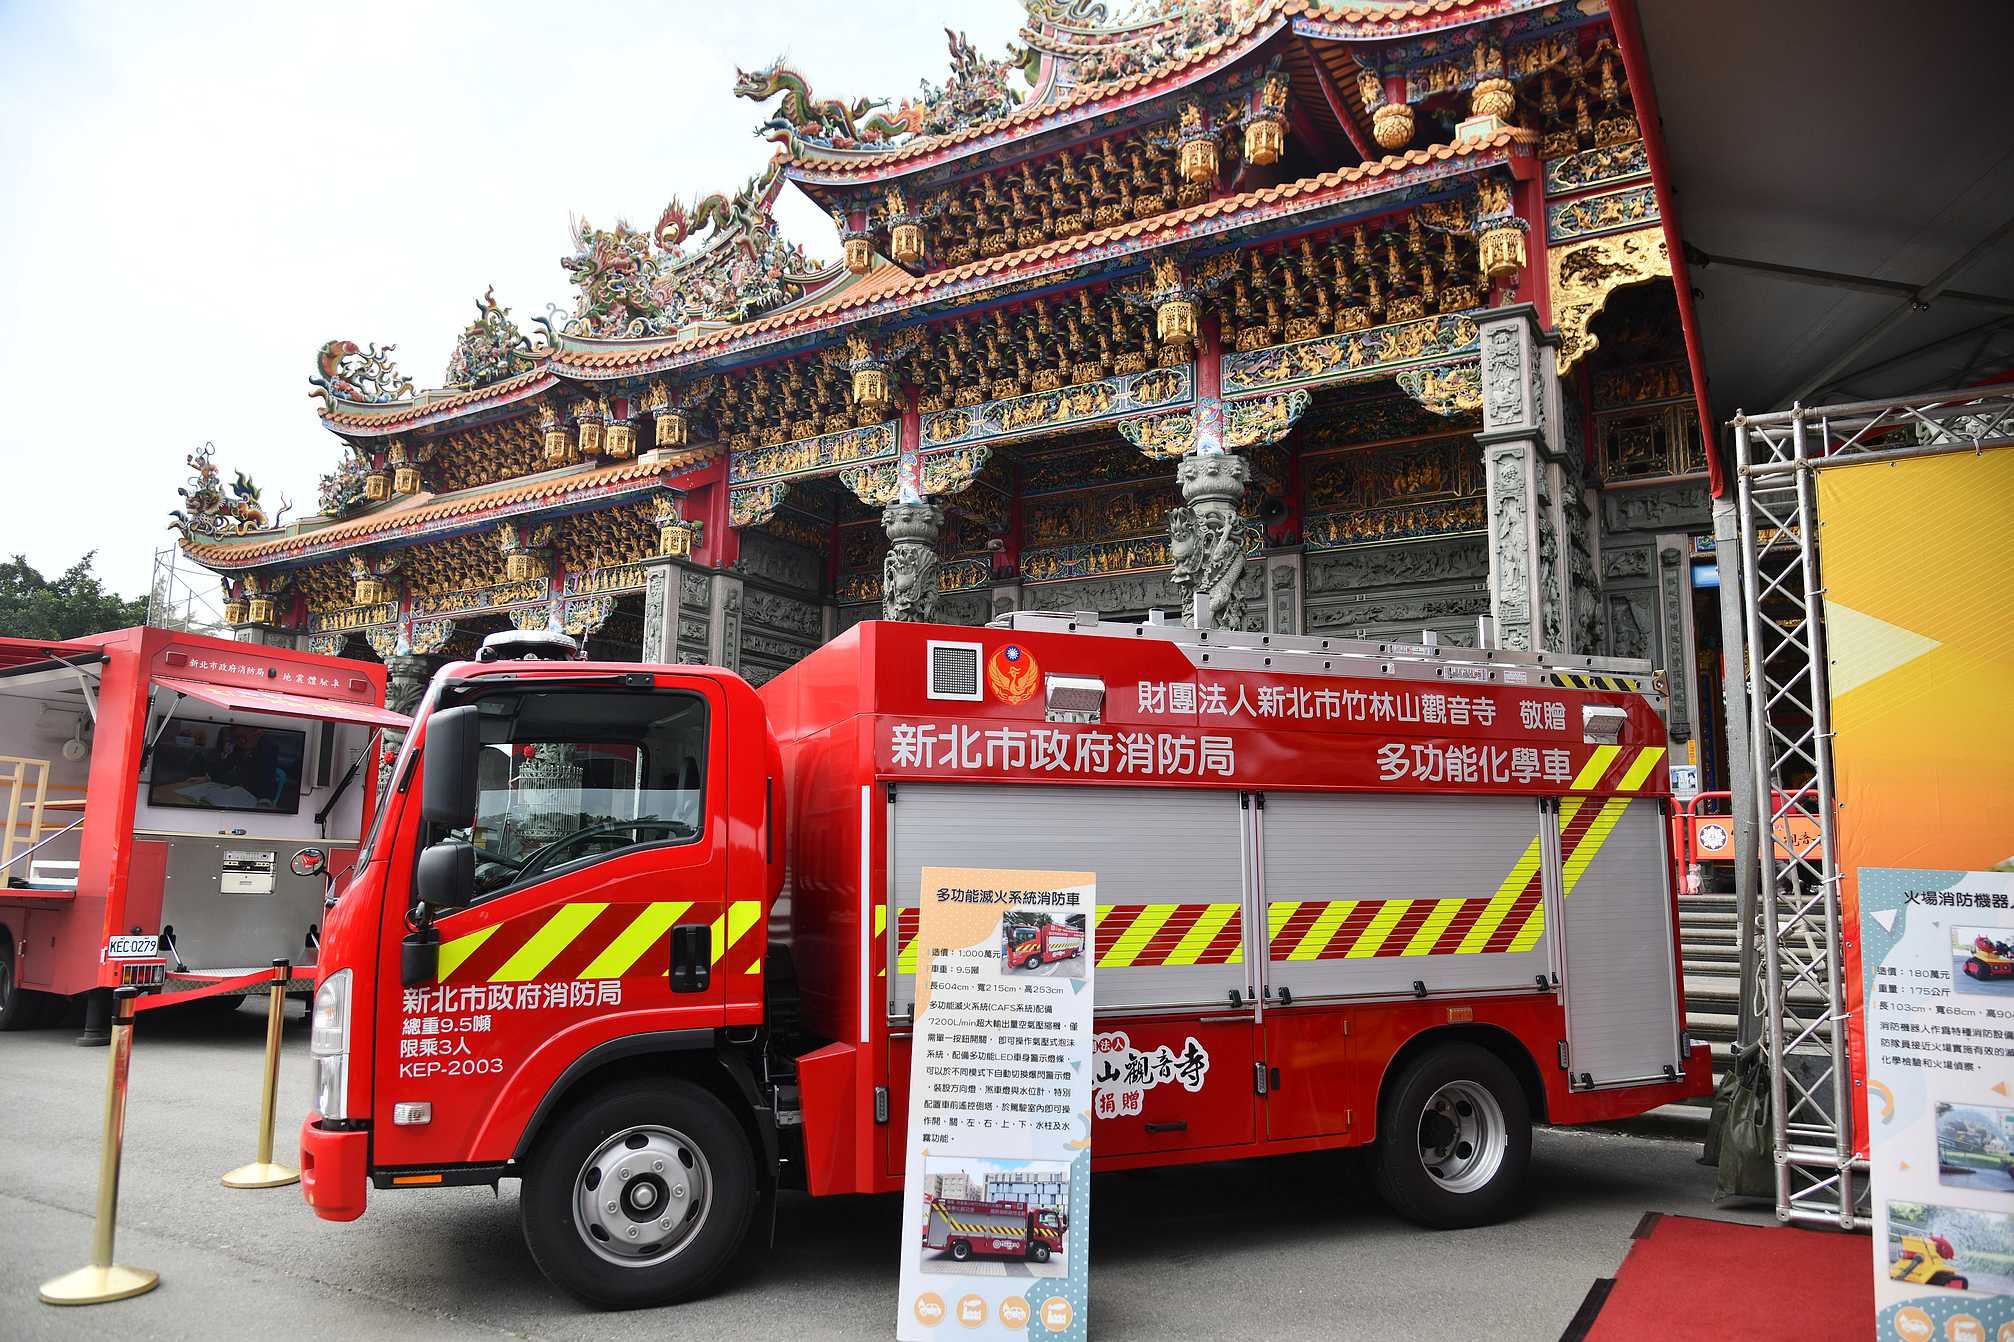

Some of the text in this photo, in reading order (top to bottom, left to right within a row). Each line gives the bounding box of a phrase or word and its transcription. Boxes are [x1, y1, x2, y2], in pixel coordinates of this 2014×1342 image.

[190, 659, 341, 688] 新北市政府消防局 地震體驗車
[1138, 681, 1566, 732] 財團法人新北市竹林山觀音寺 敬贈
[891, 723, 1236, 776] 新北市政府消防局
[1377, 743, 1573, 784] 多功能化學車
[936, 887, 1080, 907] 多功能滅火系統消防車
[1904, 890, 2014, 909] 火場消防機器
[402, 980, 622, 1014] 新北市政府消防局
[400, 1036, 472, 1058] 限乘3人
[400, 1058, 504, 1078] KEP-2003
[1092, 1042, 1205, 1087] 山觀音寺
[1100, 1090, 1140, 1113] 捐贈
